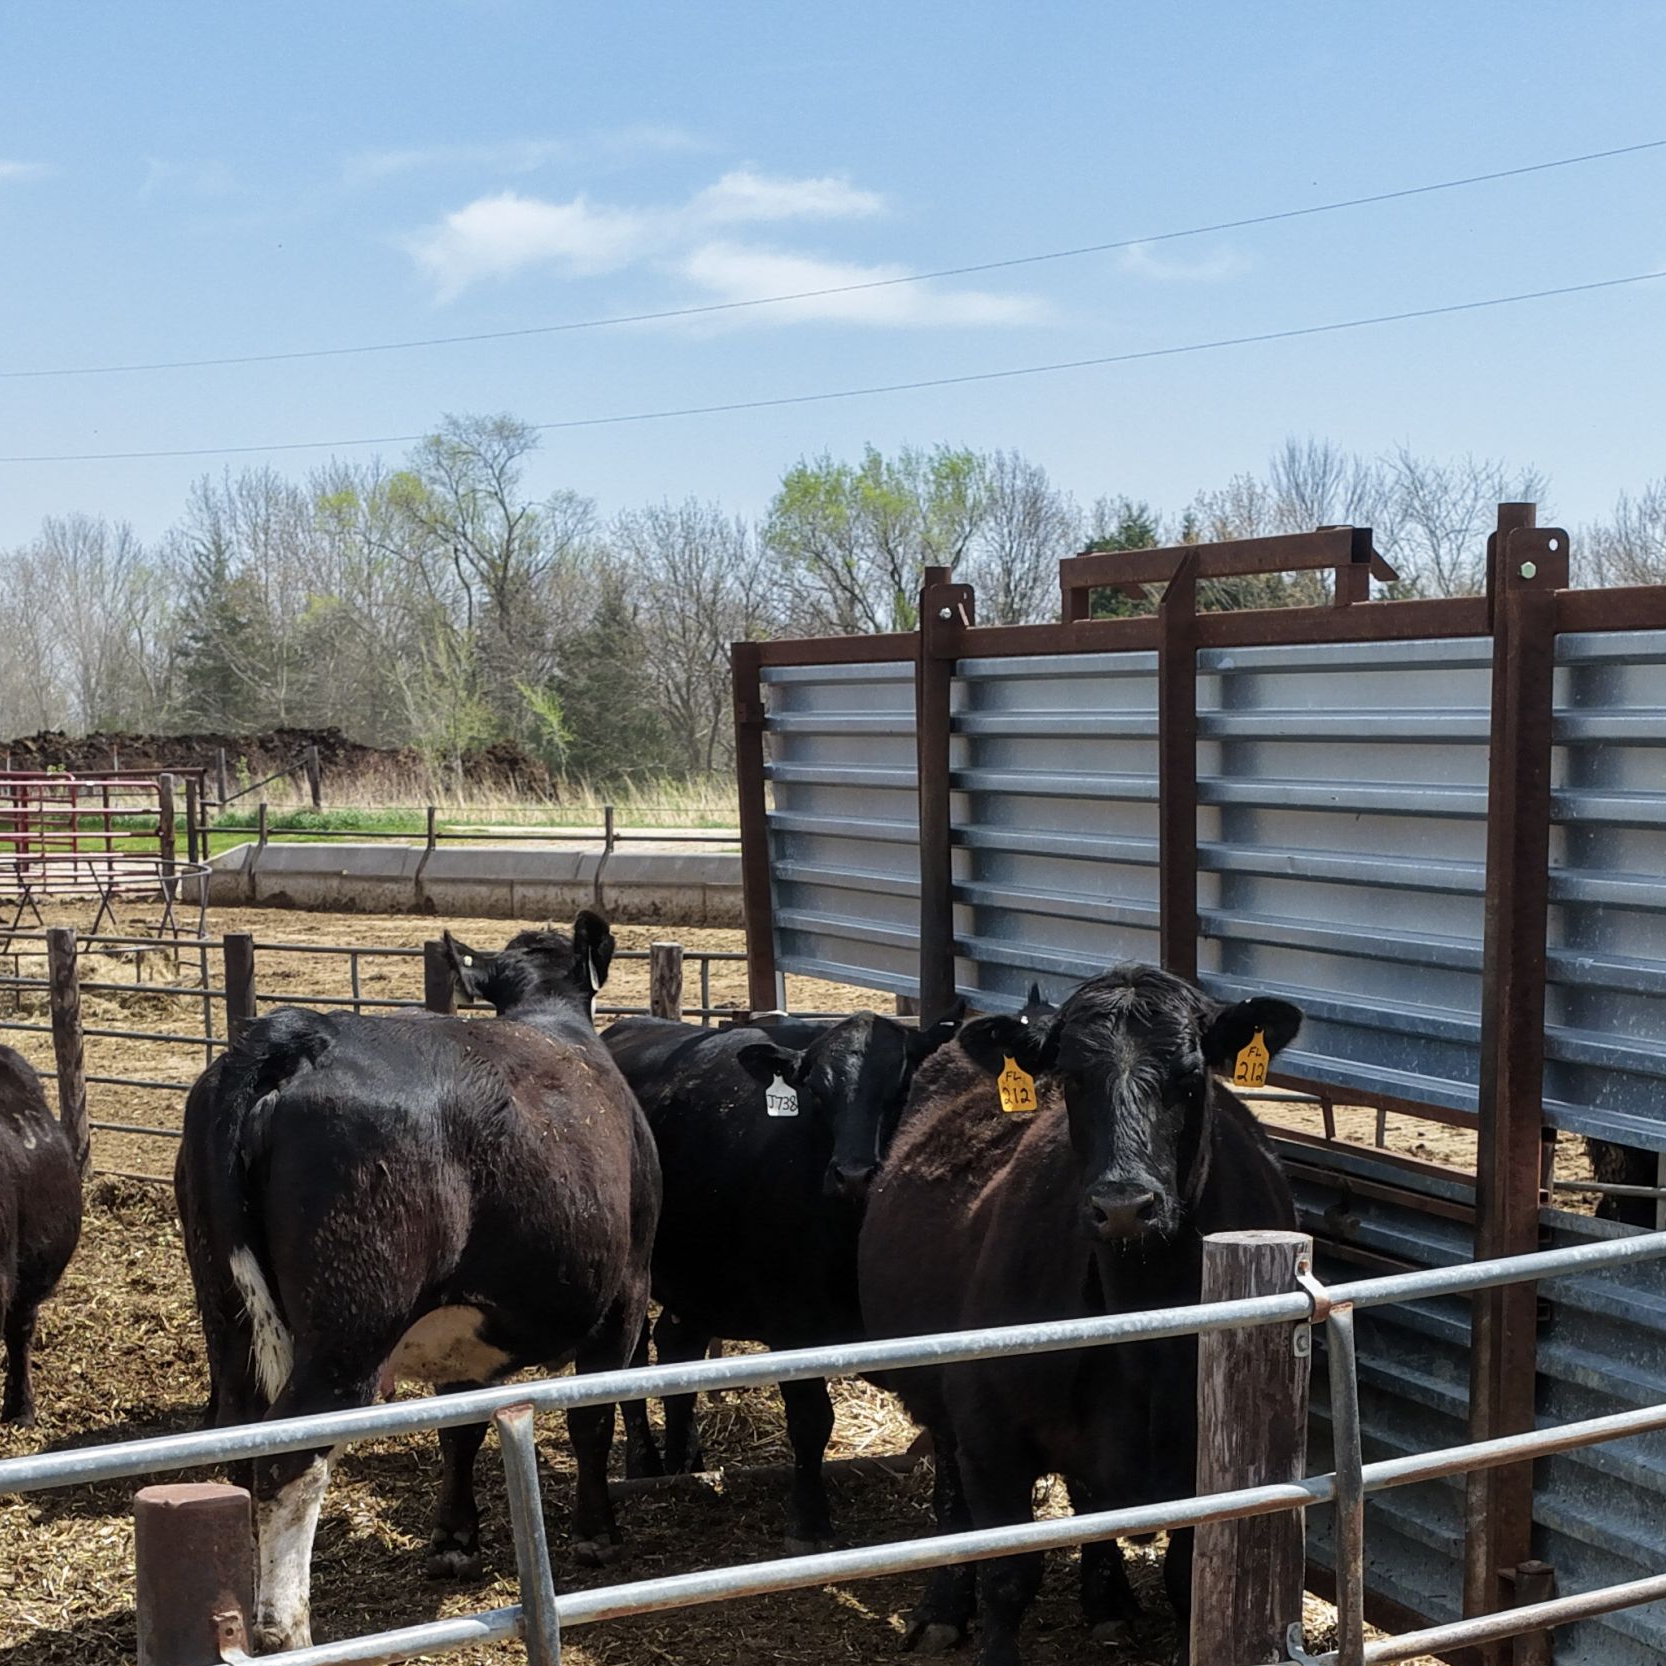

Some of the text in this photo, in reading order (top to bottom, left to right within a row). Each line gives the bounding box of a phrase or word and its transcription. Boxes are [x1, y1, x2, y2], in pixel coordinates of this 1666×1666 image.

[1247, 1046, 1262, 1057] FL
[1005, 1071, 1022, 1082] FL
[1236, 1061, 1265, 1082] 212
[767, 1095, 798, 1112] J738
[1002, 1087, 1031, 1104] 212
